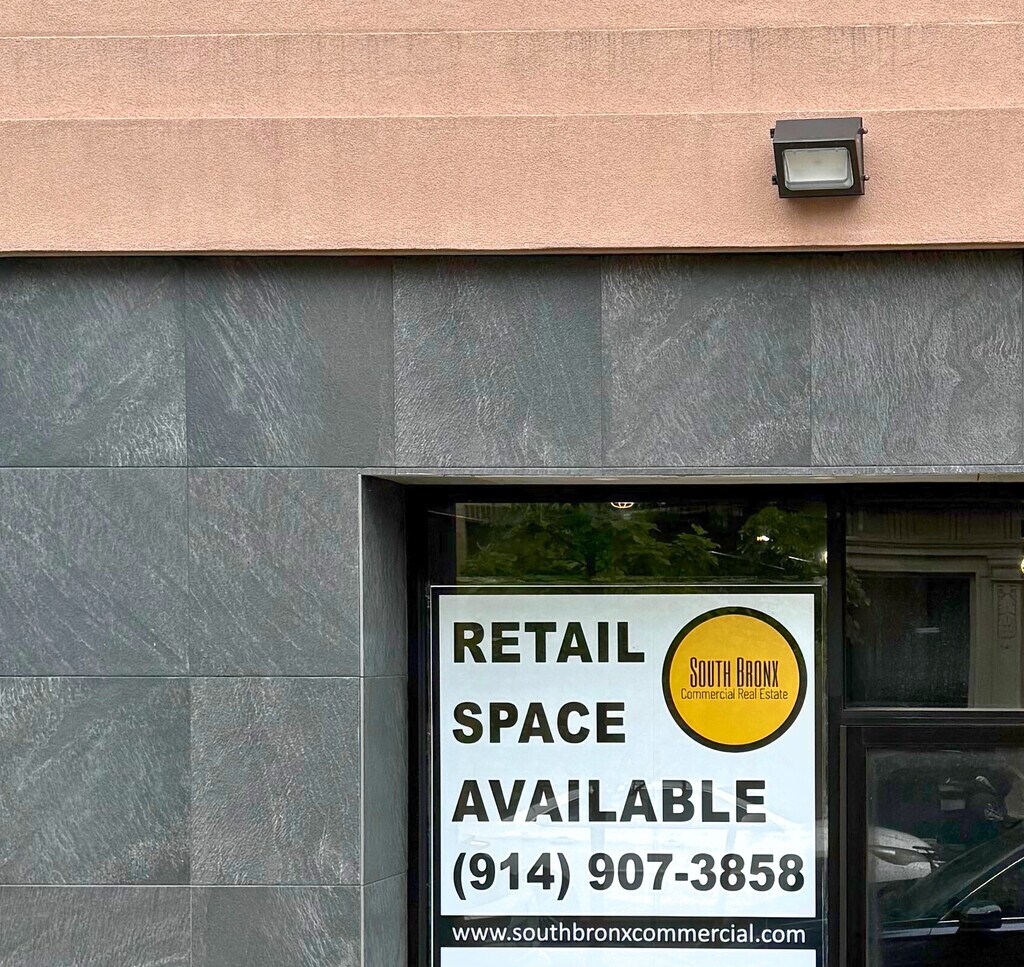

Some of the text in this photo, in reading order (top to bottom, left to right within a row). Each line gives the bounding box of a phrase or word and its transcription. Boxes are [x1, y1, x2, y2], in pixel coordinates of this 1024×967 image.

[453, 621, 645, 663] RETAIL
[681, 688, 788, 700] Commercial Real Estate
[452, 702, 626, 744] SPACE
[451, 780, 766, 823] AVAILABLE
[452, 852, 804, 901] (914) 907-3858
[452, 922, 806, 944] www.southbronxcommercial.com
